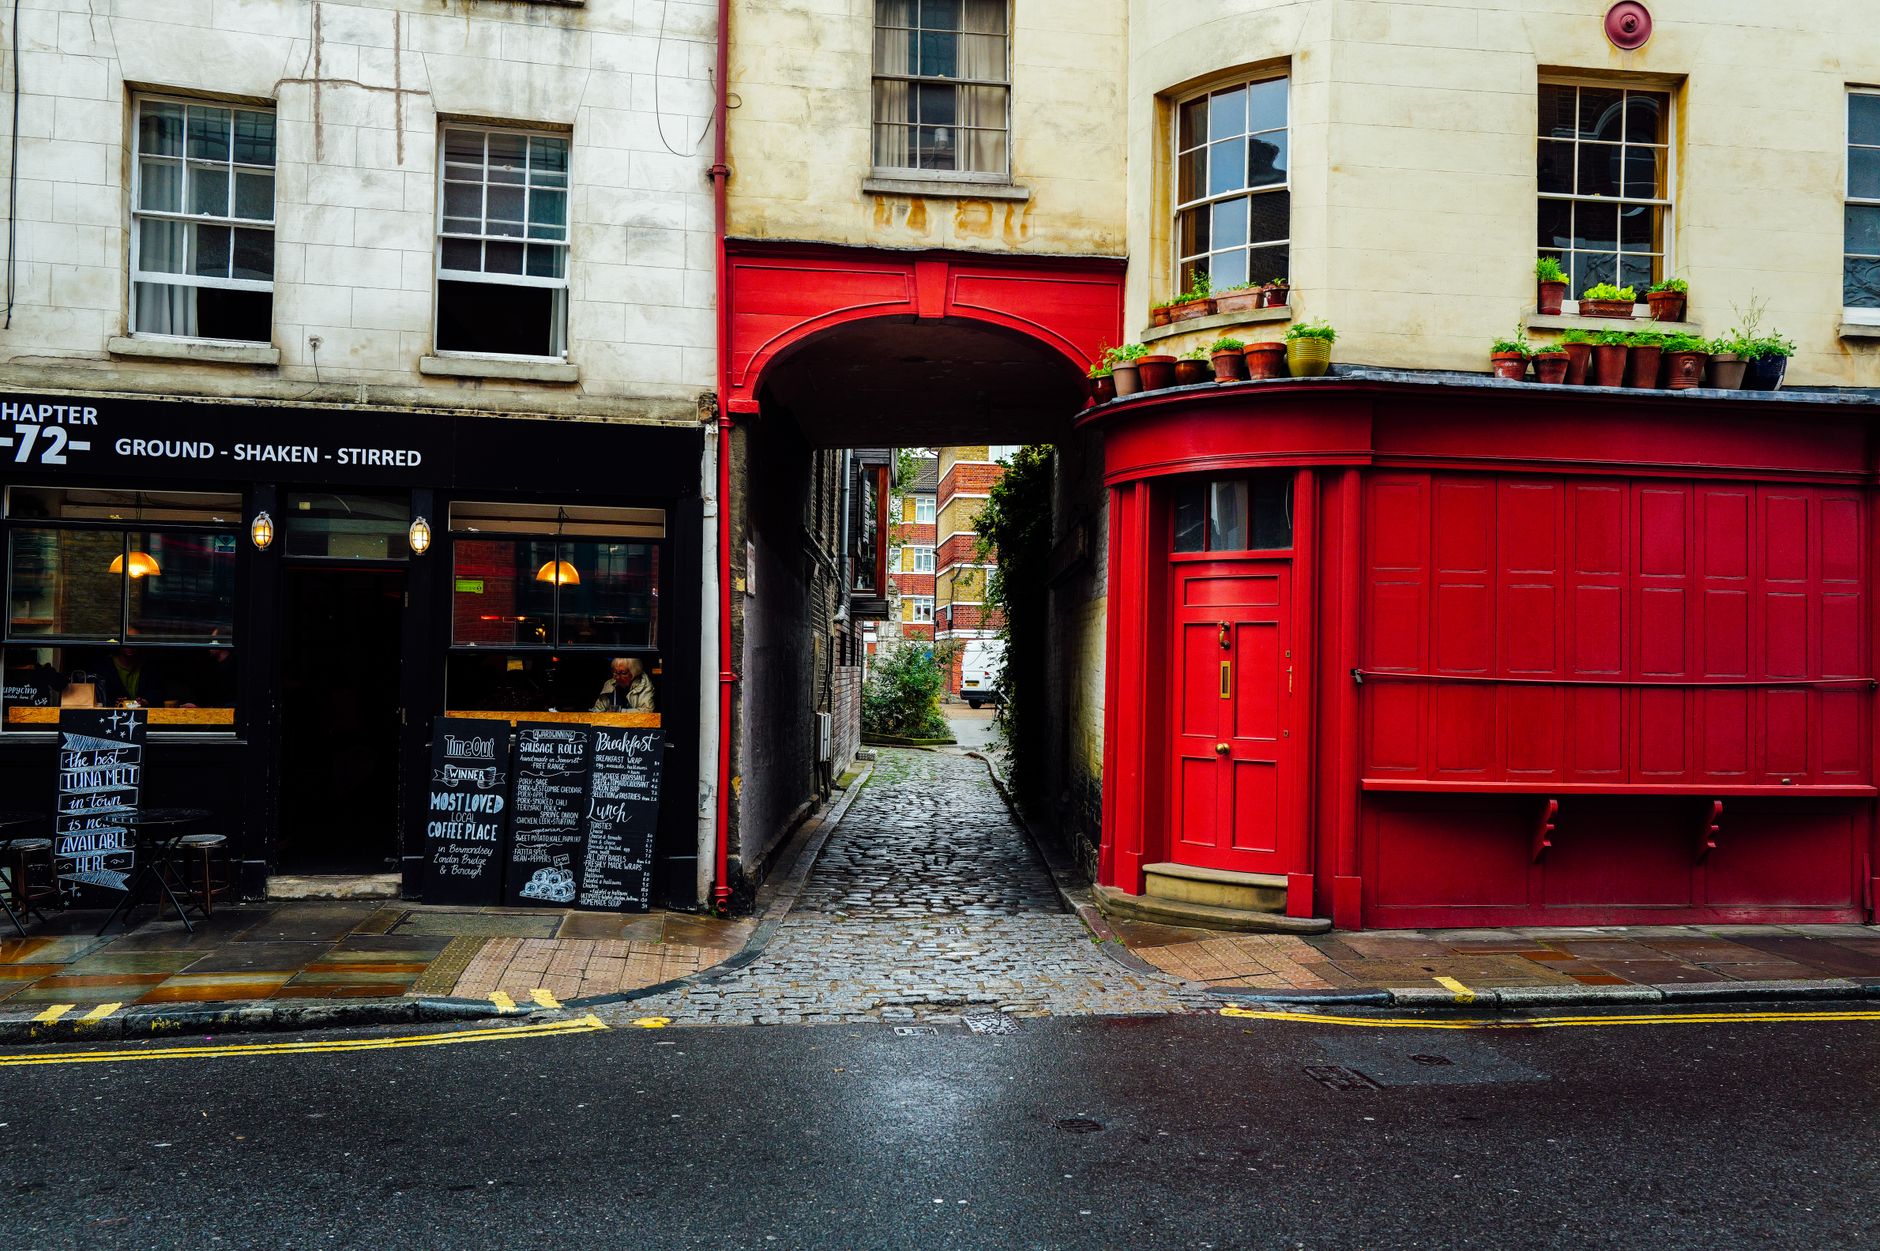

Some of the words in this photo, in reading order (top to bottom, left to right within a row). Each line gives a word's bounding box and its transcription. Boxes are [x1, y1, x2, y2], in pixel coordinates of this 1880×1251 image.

[1, 402, 98, 425] HAPTER
[115, 438, 214, 459] GROUND
[233, 443, 318, 463] SHAKEN
[337, 448, 422, 467] STIRRED
[520, 743, 554, 753] SAUSAGE
[558, 743, 583, 754] ROLLS
[595, 732, 661, 757] Breakfast
[65, 752, 89, 768] the
[95, 749, 129, 766] best
[596, 755, 624, 763] BREAKFAST
[64, 770, 102, 789] TUNA
[105, 768, 138, 786] MELT
[449, 769, 485, 781] WINNER
[68, 797, 84, 809] in
[86, 793, 122, 808] town
[430, 792, 465, 811] MOST
[465, 793, 504, 814] LOVED
[451, 812, 477, 823] LOCAL
[586, 798, 632, 823] Lunch
[68, 818, 81, 831] is
[86, 818, 110, 829] no
[428, 821, 463, 839] COFFEE
[465, 823, 498, 841] PLACE
[61, 832, 128, 853] AVAILABLE
[449, 844, 494, 857] Bermondsey
[76, 855, 107, 873] HERE
[433, 853, 459, 863] London
[461, 854, 487, 866] Bridge
[440, 865, 447, 875] &
